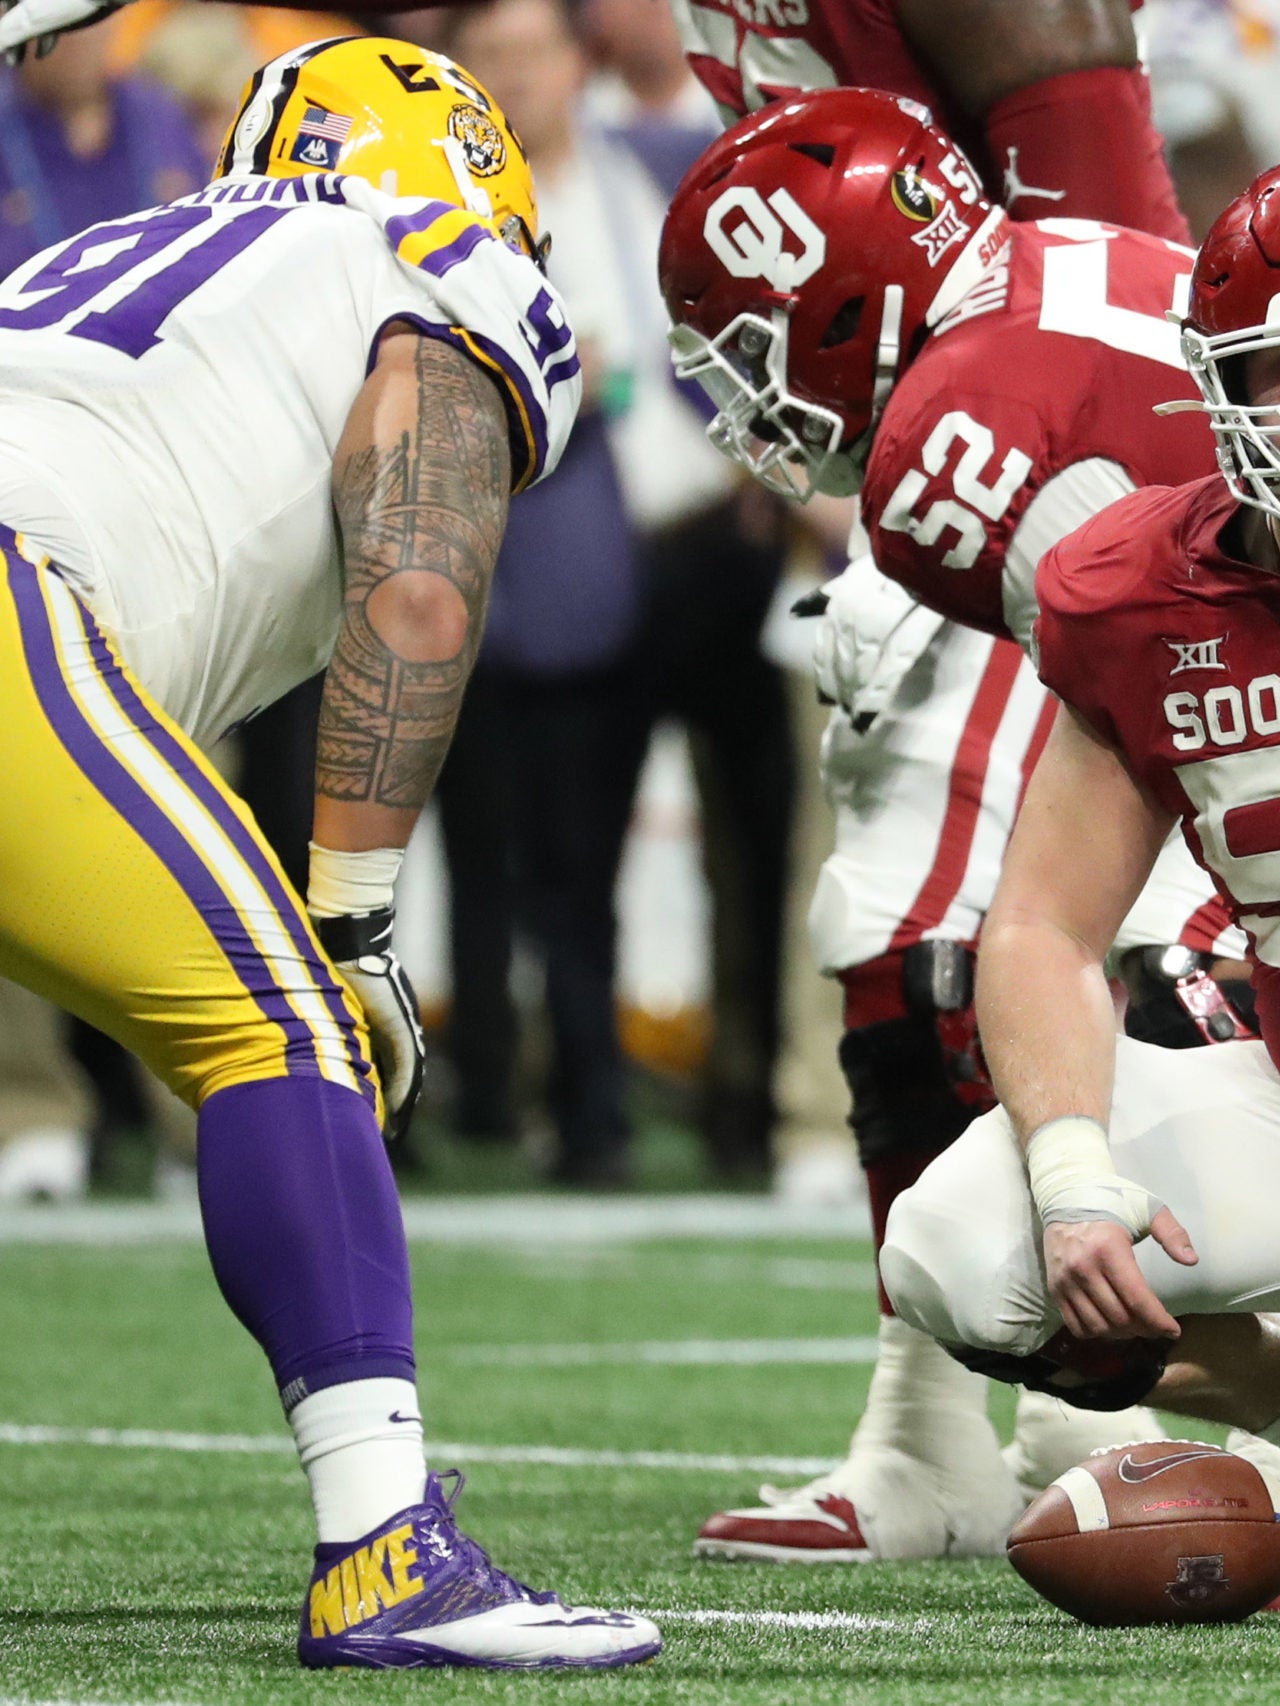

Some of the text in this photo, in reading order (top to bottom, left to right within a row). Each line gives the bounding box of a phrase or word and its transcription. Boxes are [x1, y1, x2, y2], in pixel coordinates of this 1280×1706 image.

[0, 203, 305, 360] 91
[703, 185, 826, 292] OU
[880, 410, 1033, 570] 52
[310, 1523, 425, 1639] NIKE
